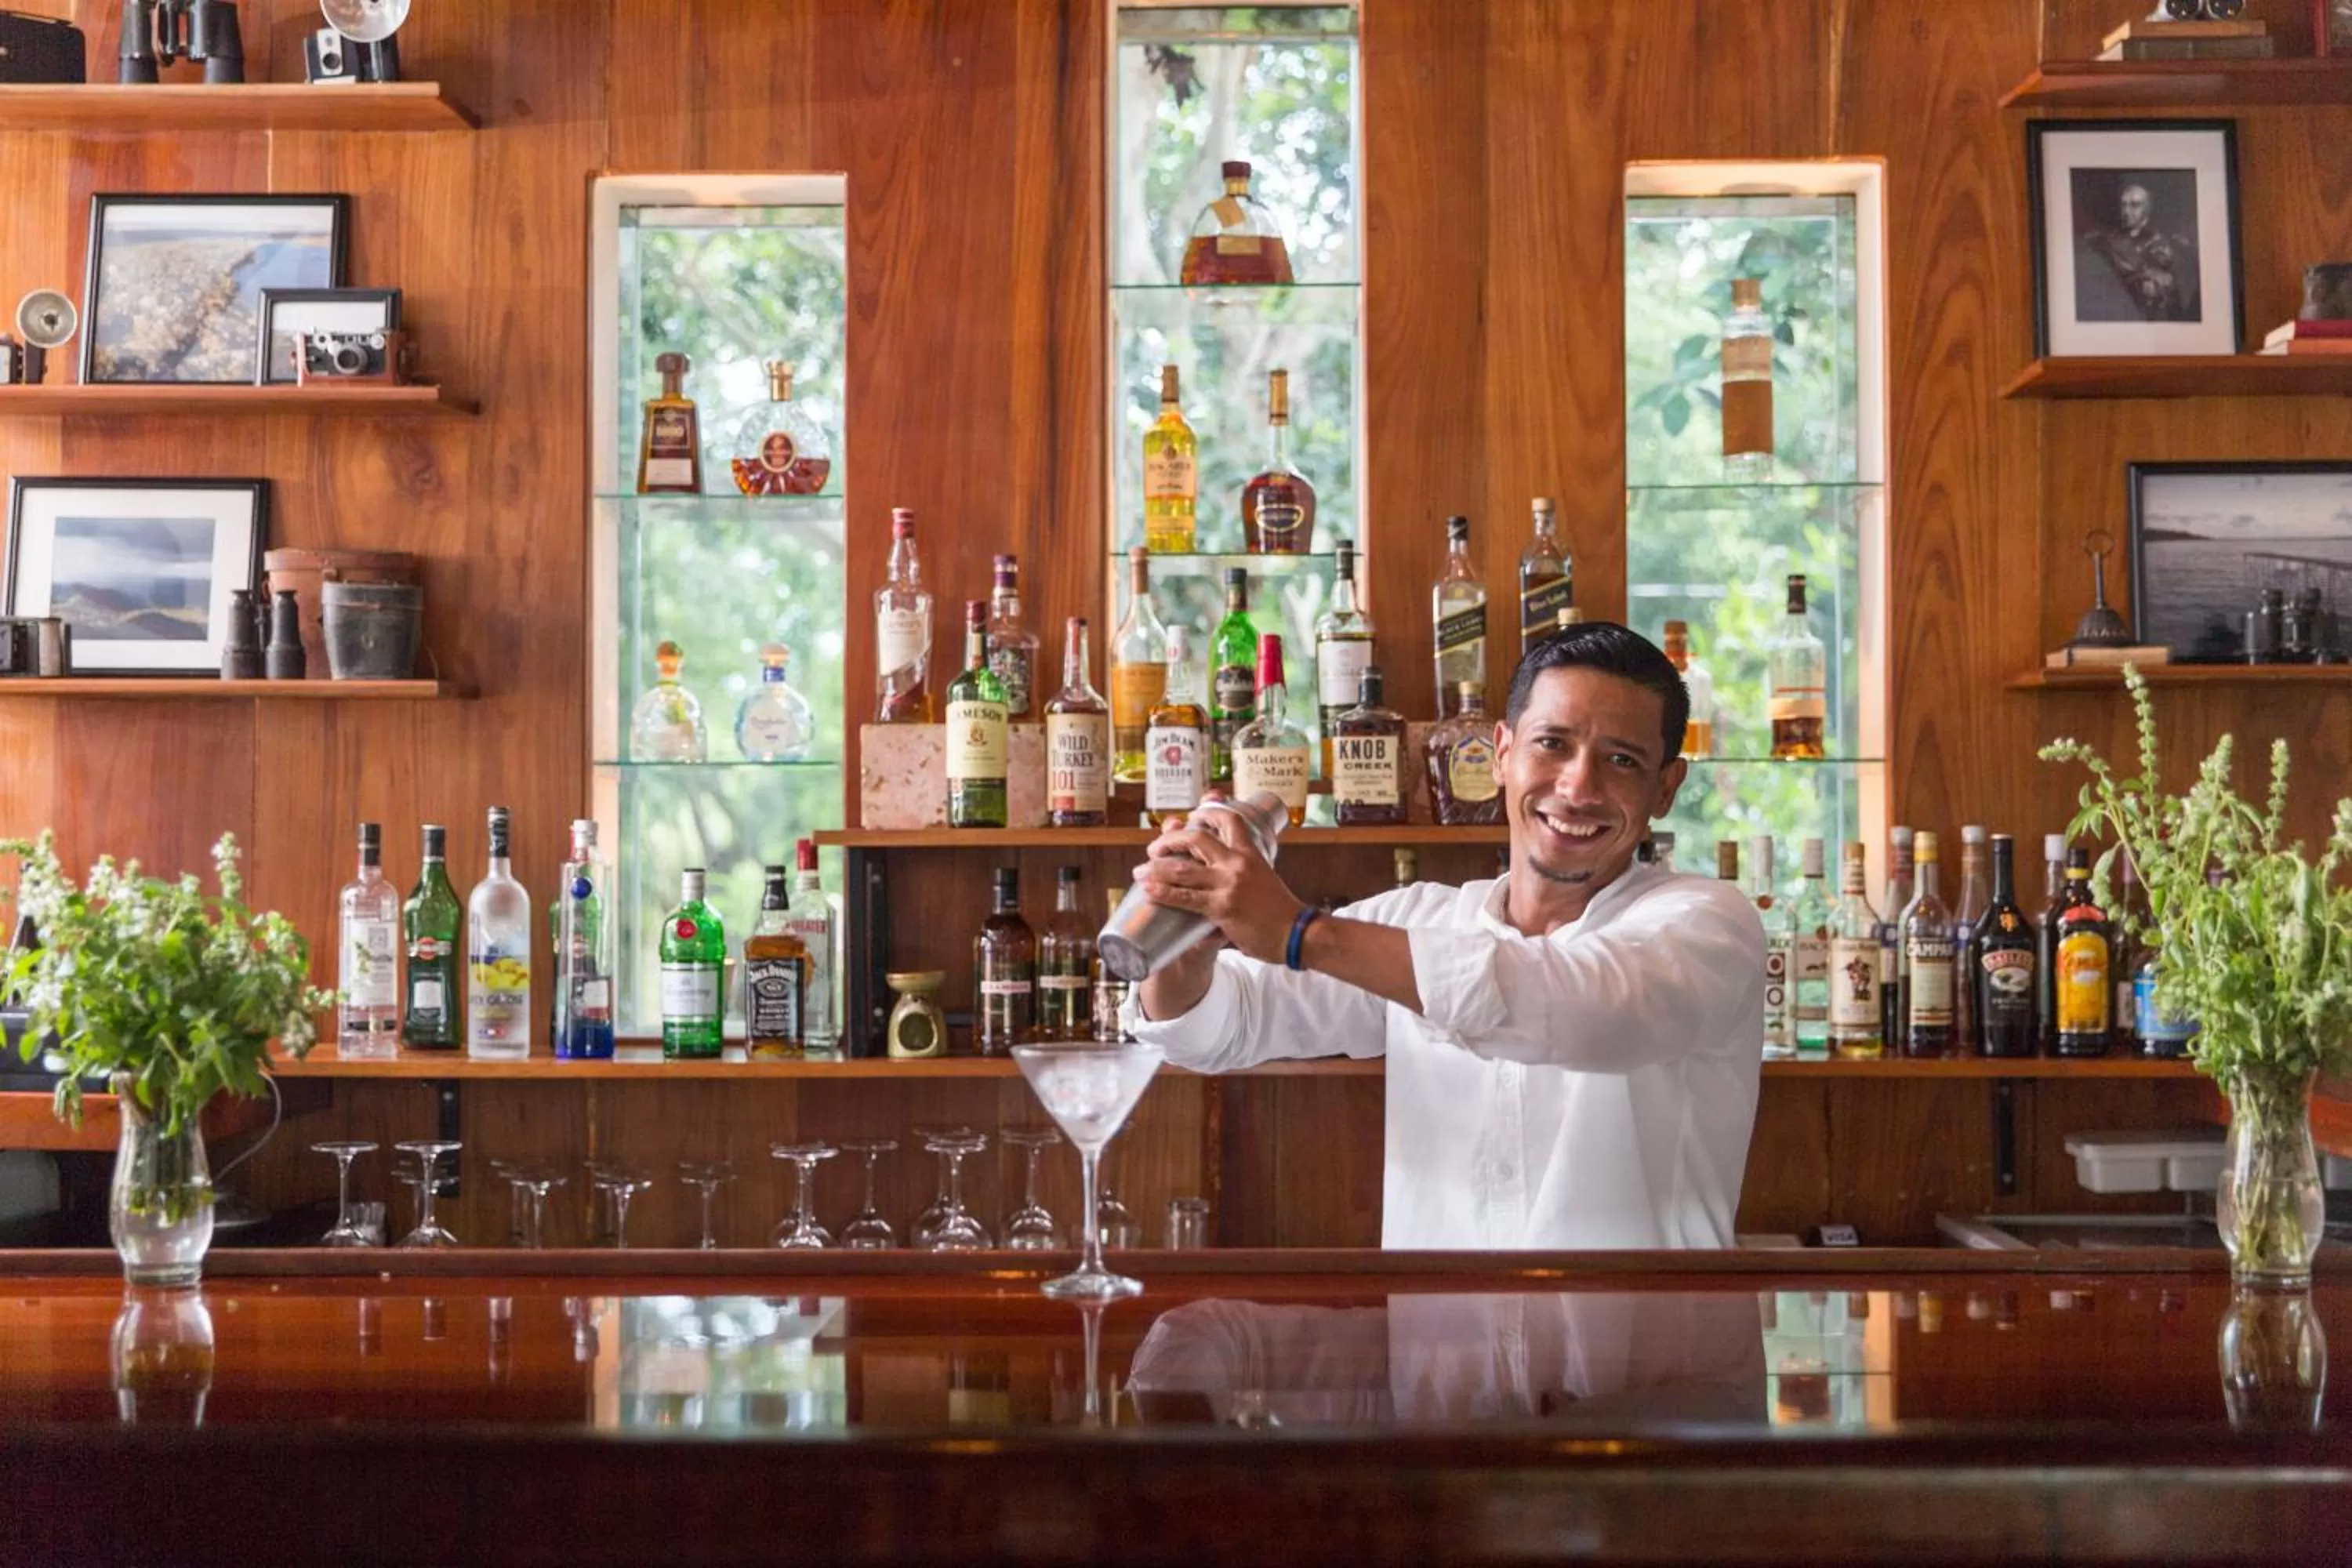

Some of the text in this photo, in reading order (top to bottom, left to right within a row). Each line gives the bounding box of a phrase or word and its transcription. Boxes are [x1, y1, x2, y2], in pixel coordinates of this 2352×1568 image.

[951, 707, 1004, 722] AMESON
[1057, 733, 1088, 750] WILD
[1339, 739, 1386, 760] KNOB
[1052, 750, 1094, 767] TURKEY
[1343, 761, 1393, 771] CREEK
[1053, 769, 1075, 790] 101
[1264, 765, 1304, 777] Mark
